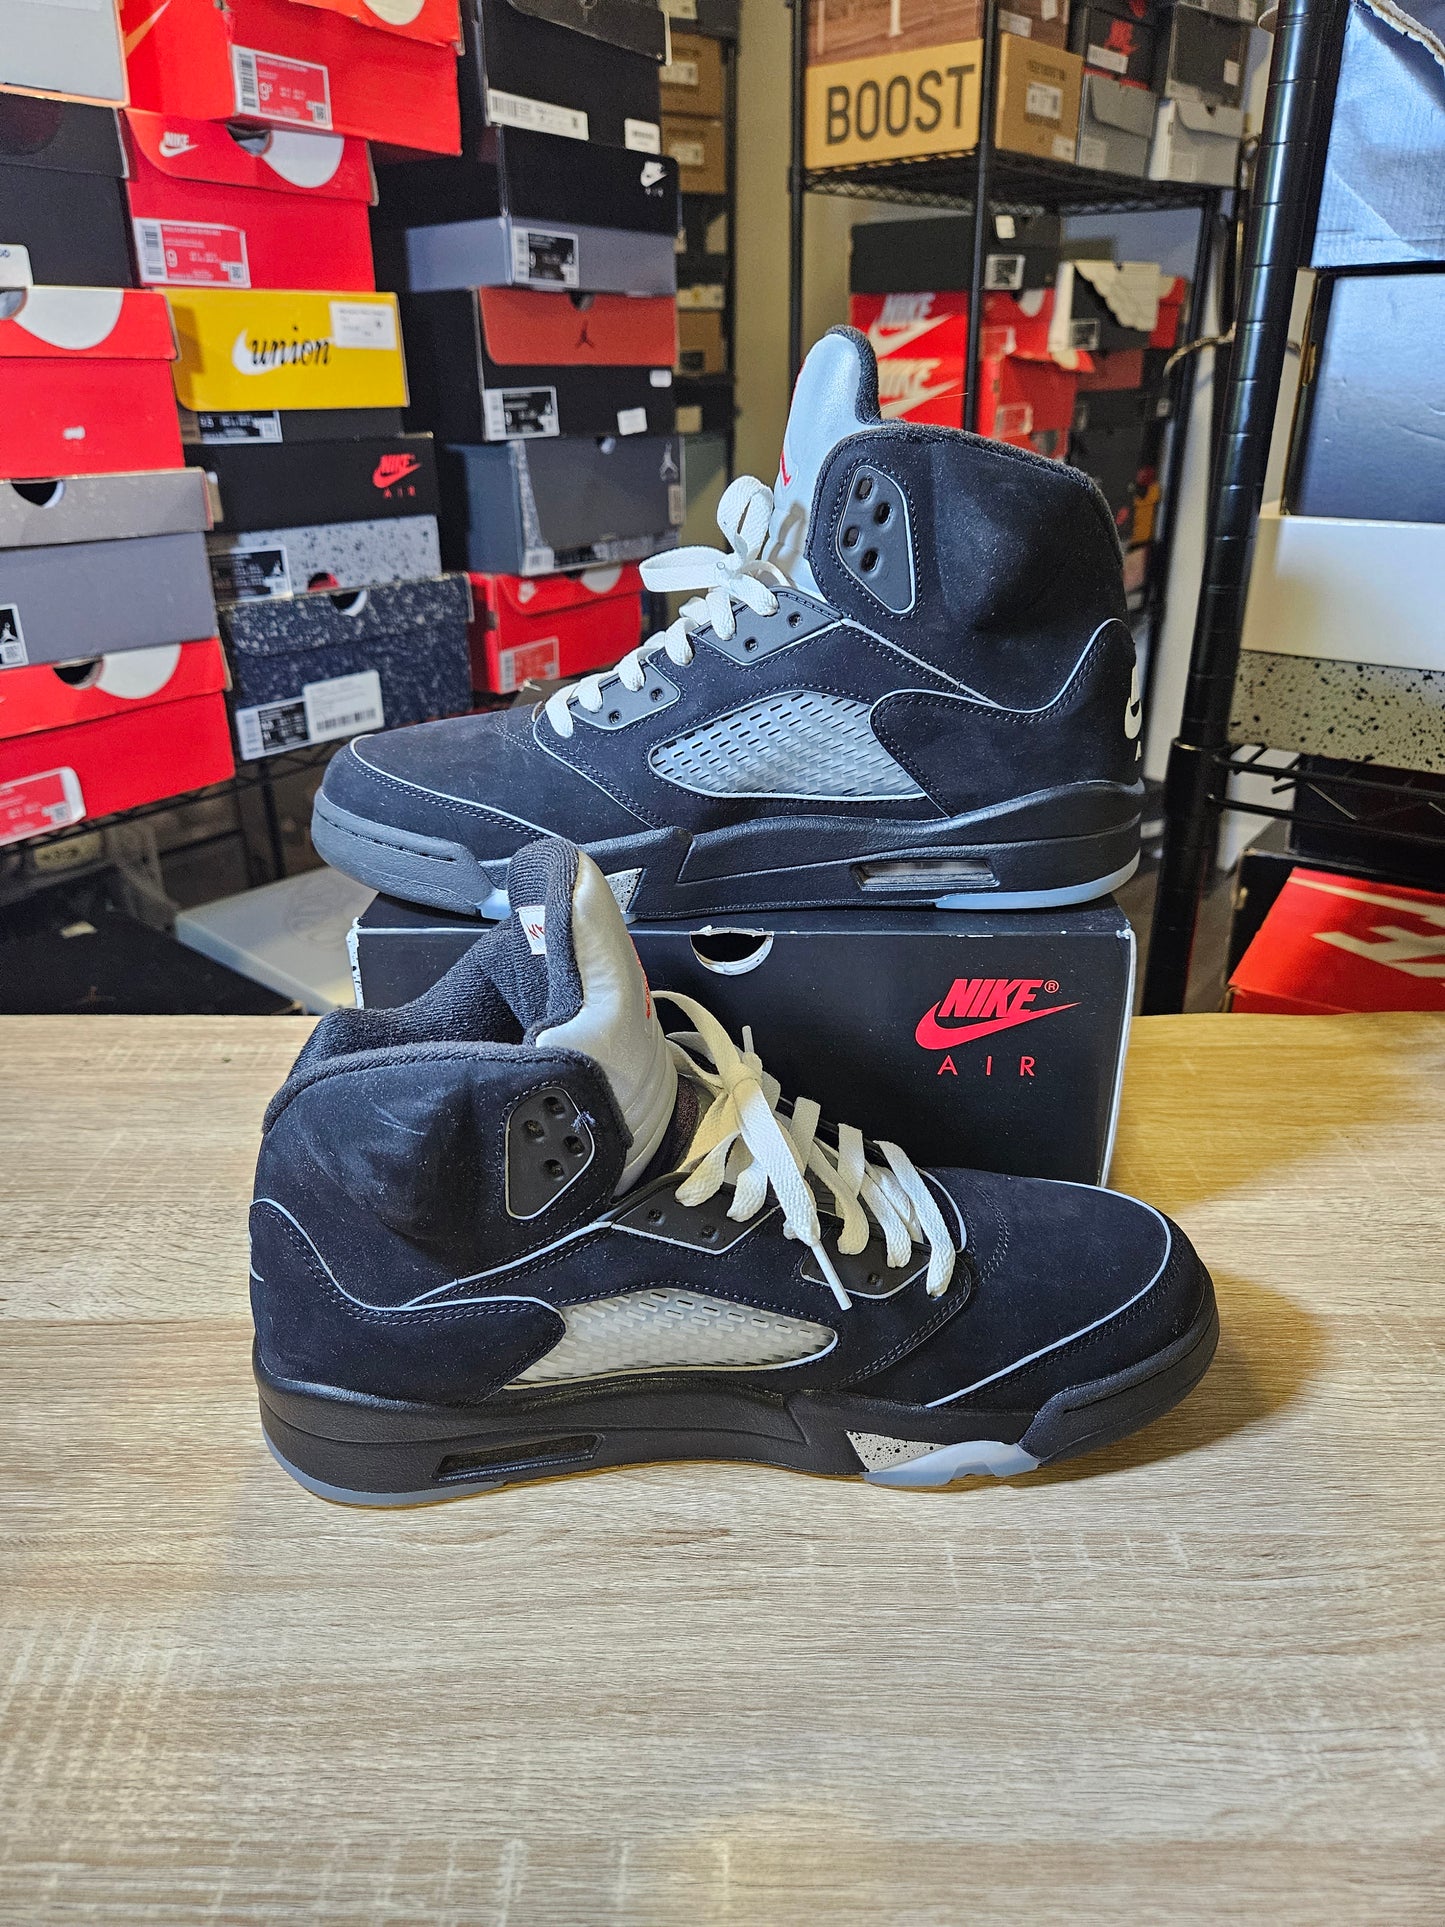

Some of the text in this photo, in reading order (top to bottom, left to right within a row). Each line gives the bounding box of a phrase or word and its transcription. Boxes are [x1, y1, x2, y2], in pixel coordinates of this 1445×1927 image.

[826, 63, 976, 147] BOOST
[251, 324, 331, 367] union
[937, 1054, 1036, 1077] AIR
